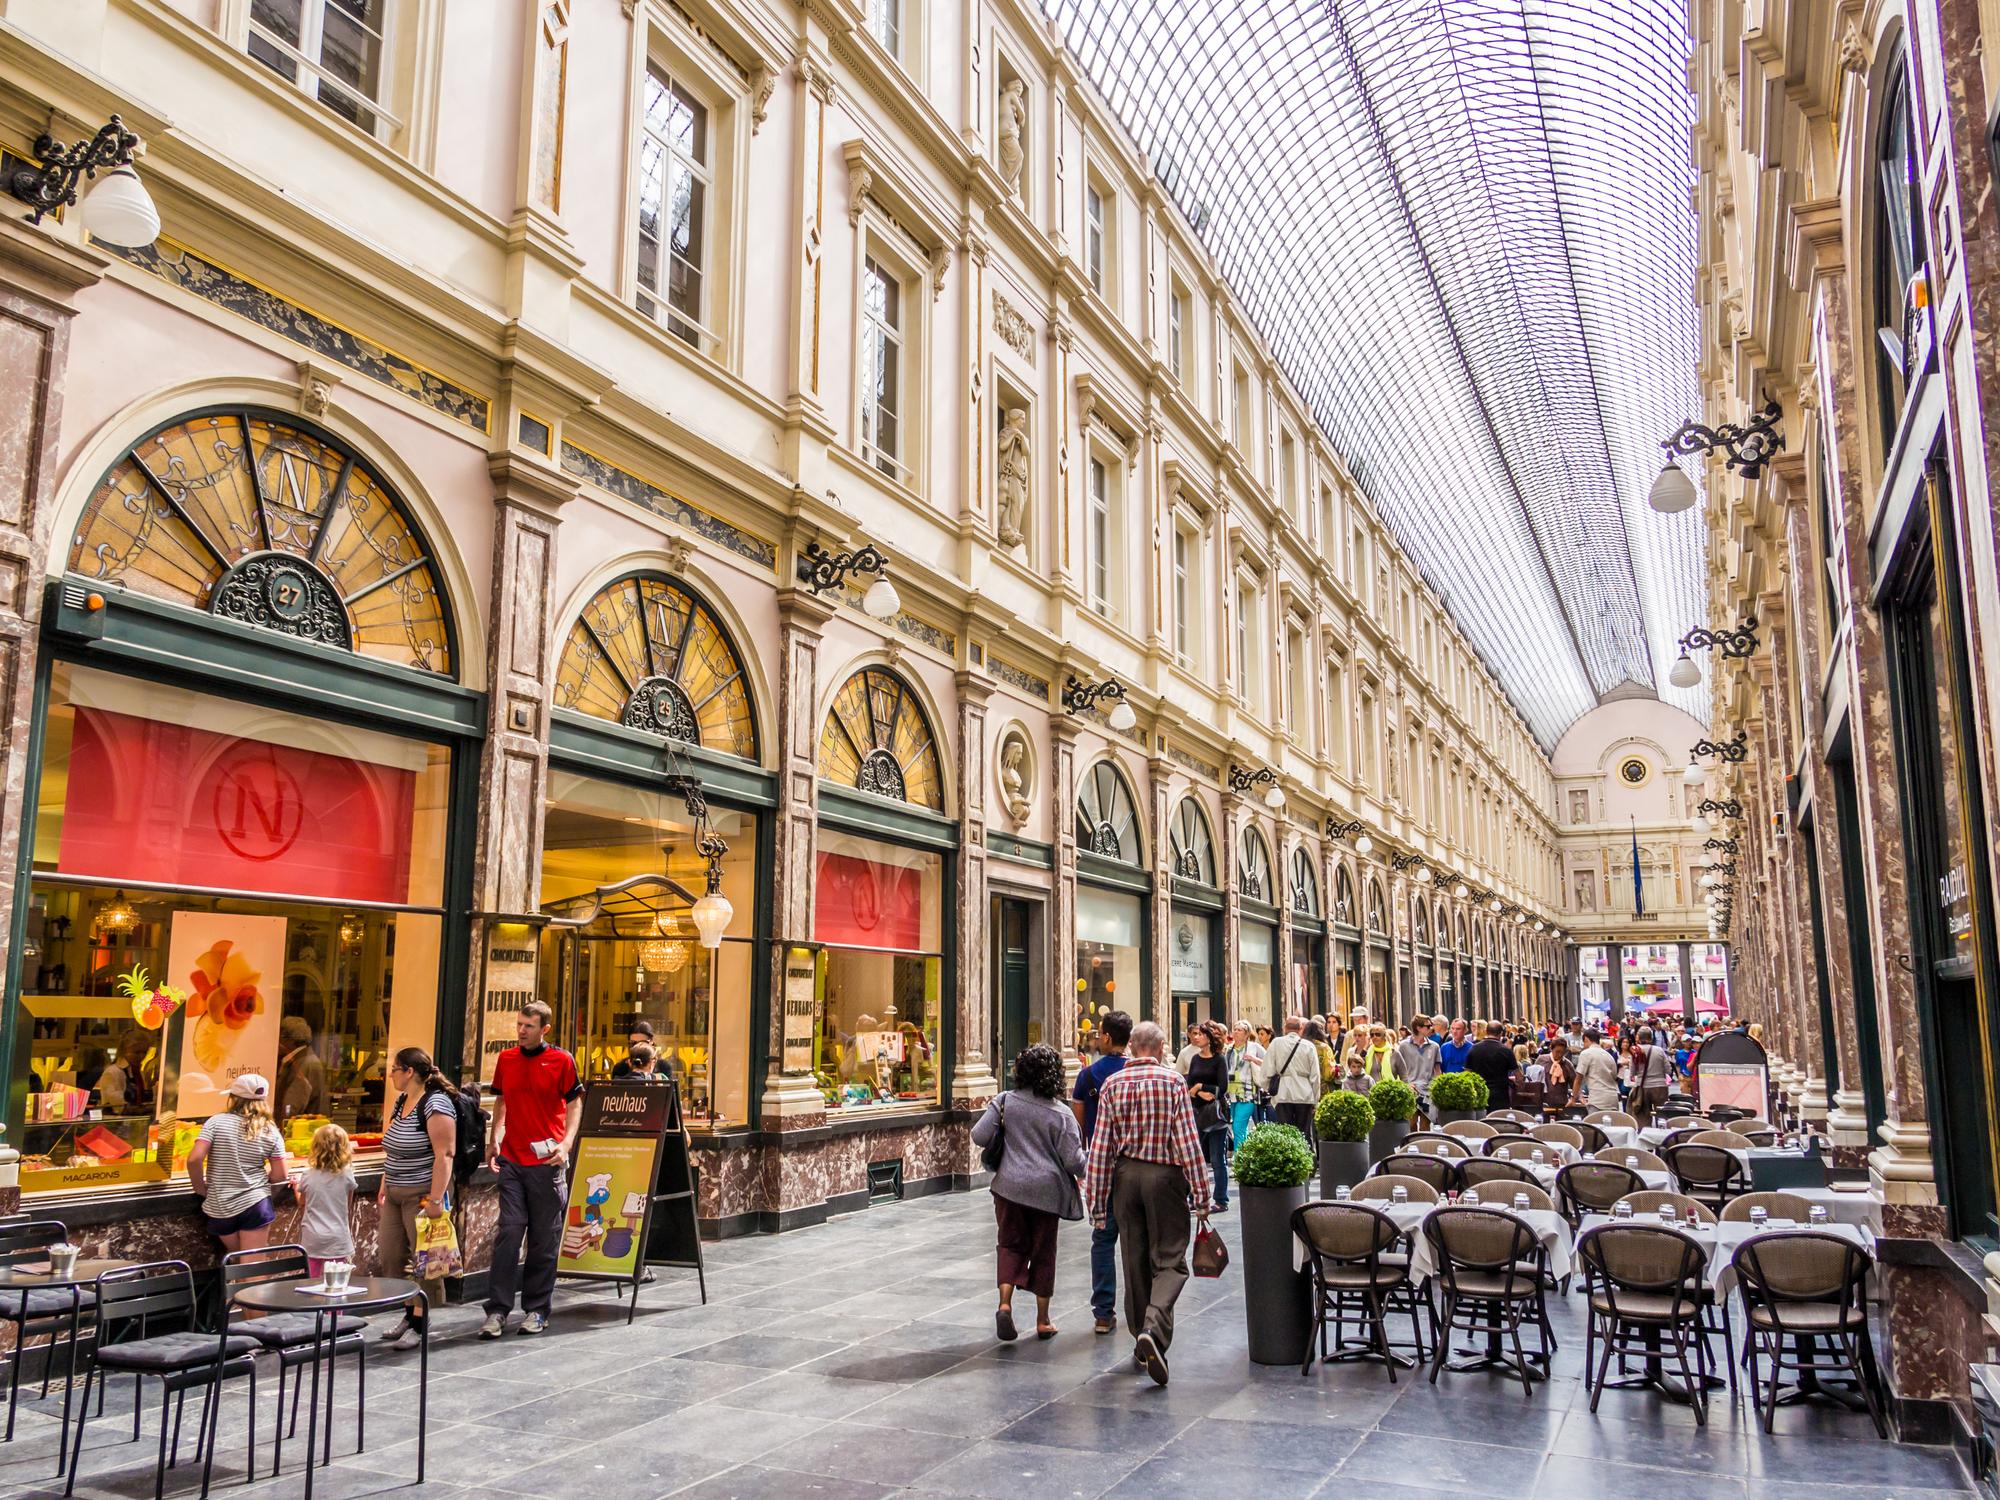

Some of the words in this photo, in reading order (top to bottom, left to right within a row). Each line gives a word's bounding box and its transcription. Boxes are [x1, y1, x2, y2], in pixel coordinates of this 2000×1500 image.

[278, 584, 301, 606] 27
[658, 700, 671, 717] 25
[231, 774, 287, 843] N
[786, 1000, 813, 1017] NEUHAUS
[602, 1091, 648, 1113] neuhaus
[63, 1170, 120, 1182] MACARONS
